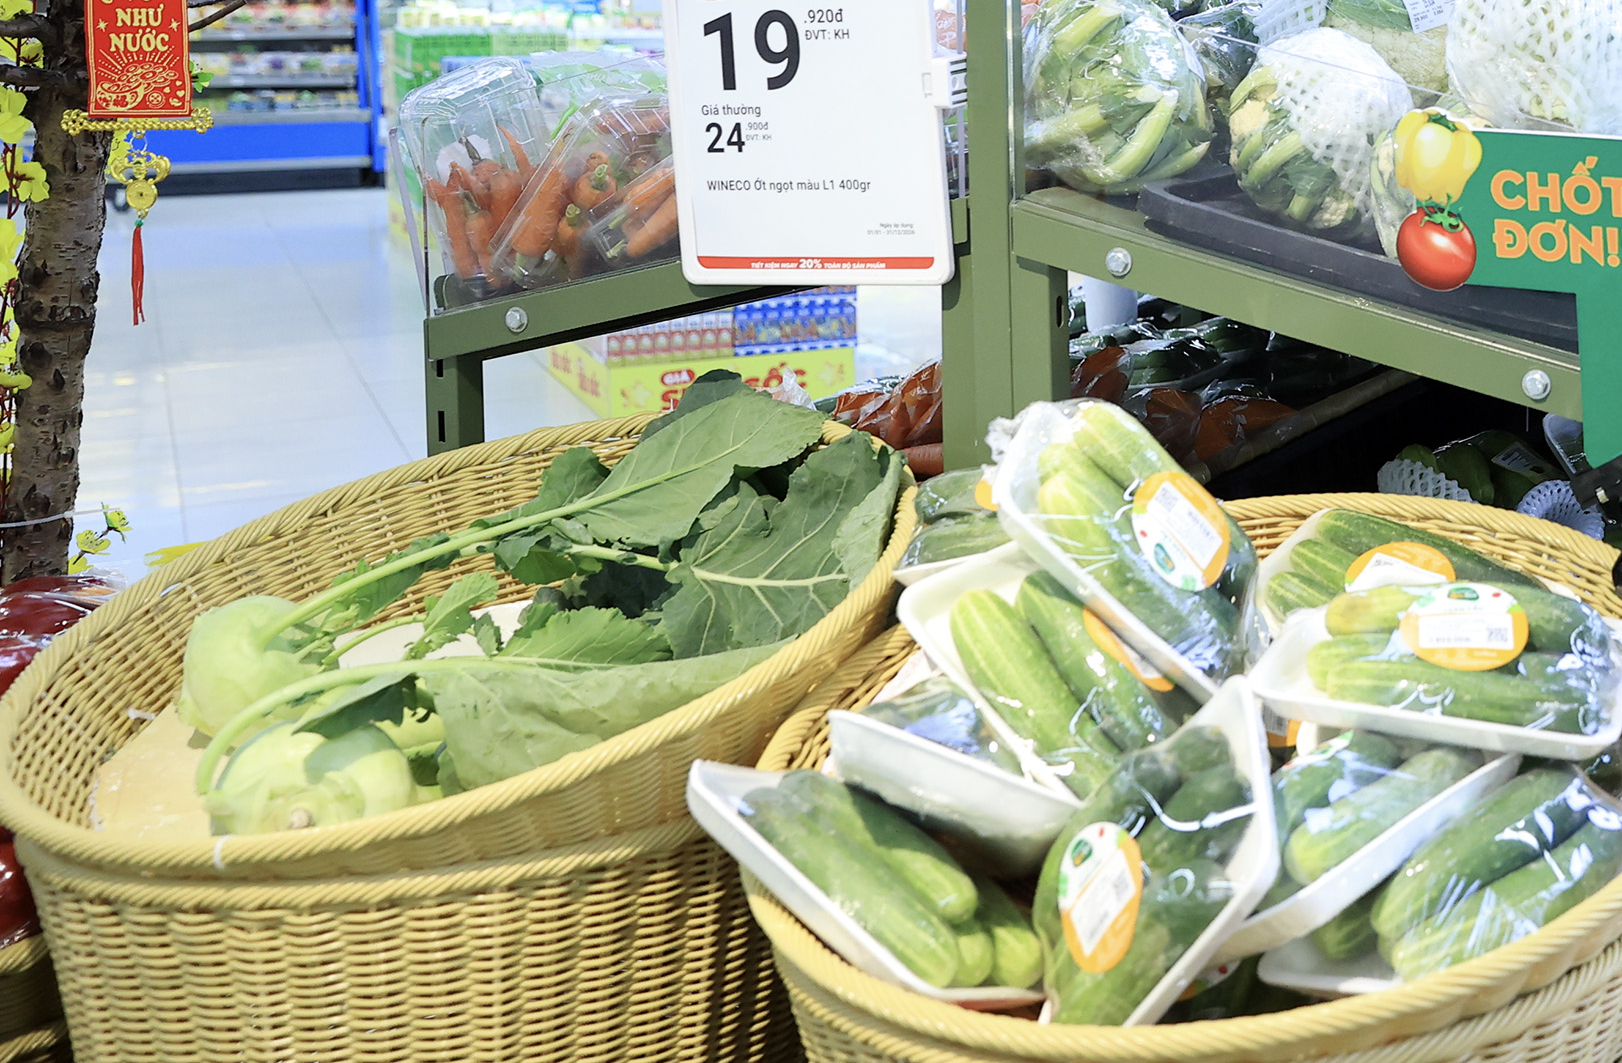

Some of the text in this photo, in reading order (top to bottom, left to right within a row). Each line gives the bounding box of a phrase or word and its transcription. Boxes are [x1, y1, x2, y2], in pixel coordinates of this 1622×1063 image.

[115, 4, 164, 26] NHƯ
[804, 9, 843, 23] .920đ
[109, 28, 169, 52] NƯỚC
[805, 29, 850, 40] ĐVT: KH
[704, 10, 800, 90] 19
[701, 104, 761, 117] Giá thường
[705, 122, 745, 153] 24
[707, 177, 870, 193] WINECO Ớt ngọt màu L1 400gr
[799, 259, 823, 268] 20%
